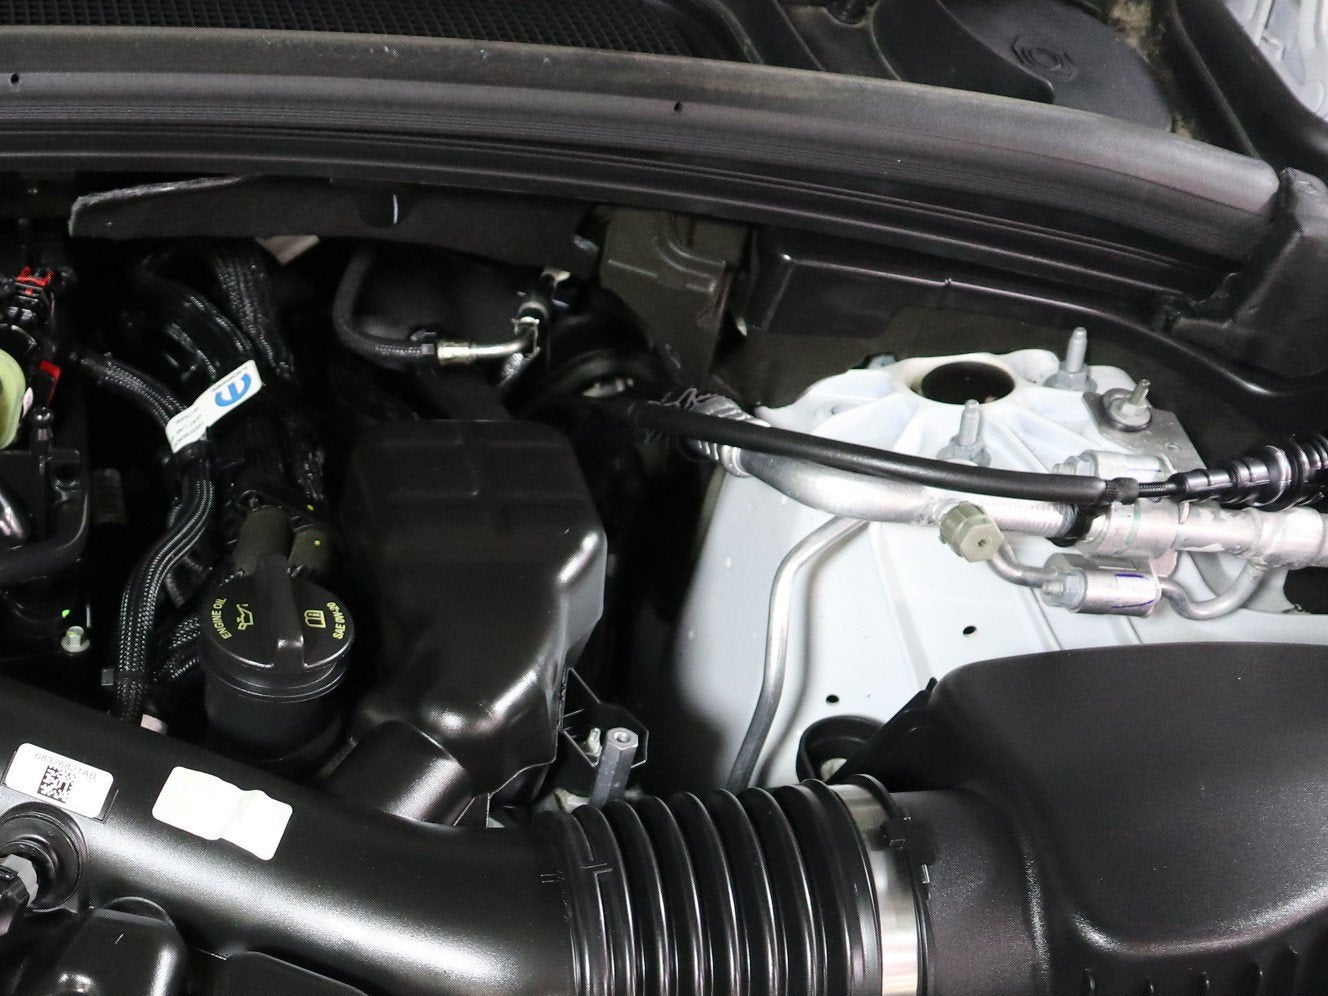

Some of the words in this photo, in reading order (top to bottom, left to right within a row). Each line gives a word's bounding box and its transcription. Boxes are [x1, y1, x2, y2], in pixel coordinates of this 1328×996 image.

[213, 598, 227, 610] OIL
[212, 609, 232, 639] ENGINE
[332, 624, 346, 640] SAE
